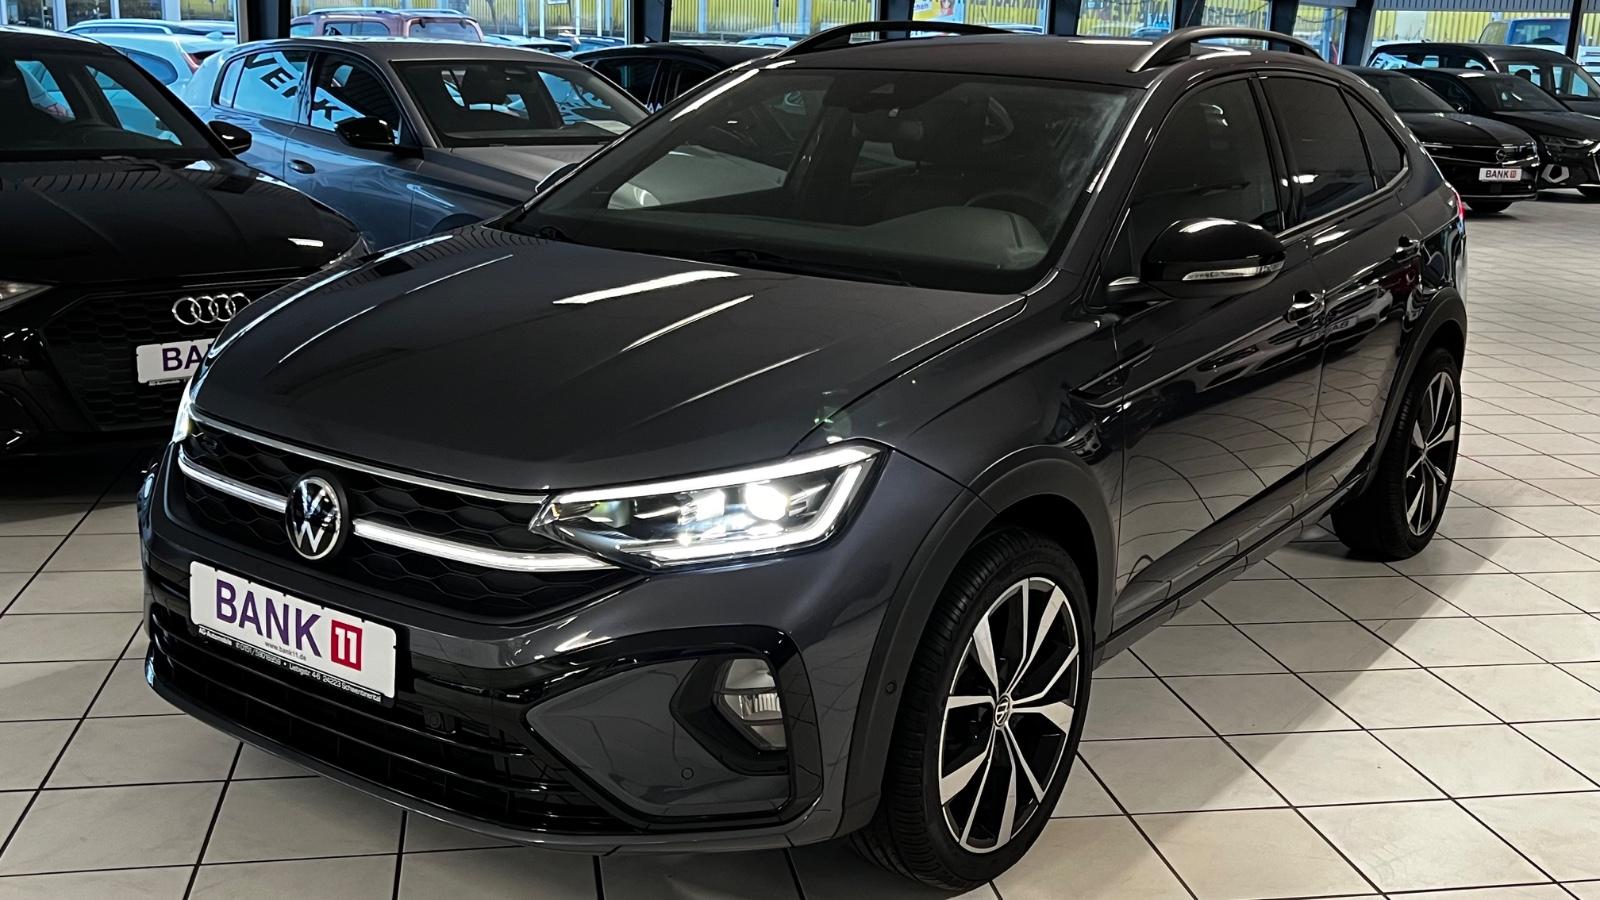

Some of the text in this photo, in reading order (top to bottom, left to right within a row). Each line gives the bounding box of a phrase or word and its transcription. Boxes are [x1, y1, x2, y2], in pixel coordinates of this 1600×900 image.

[1485, 169, 1509, 178] BANK
[162, 344, 209, 372] BA
[216, 578, 358, 666] BANK 11
[264, 641, 307, 661] www.bank11.de
